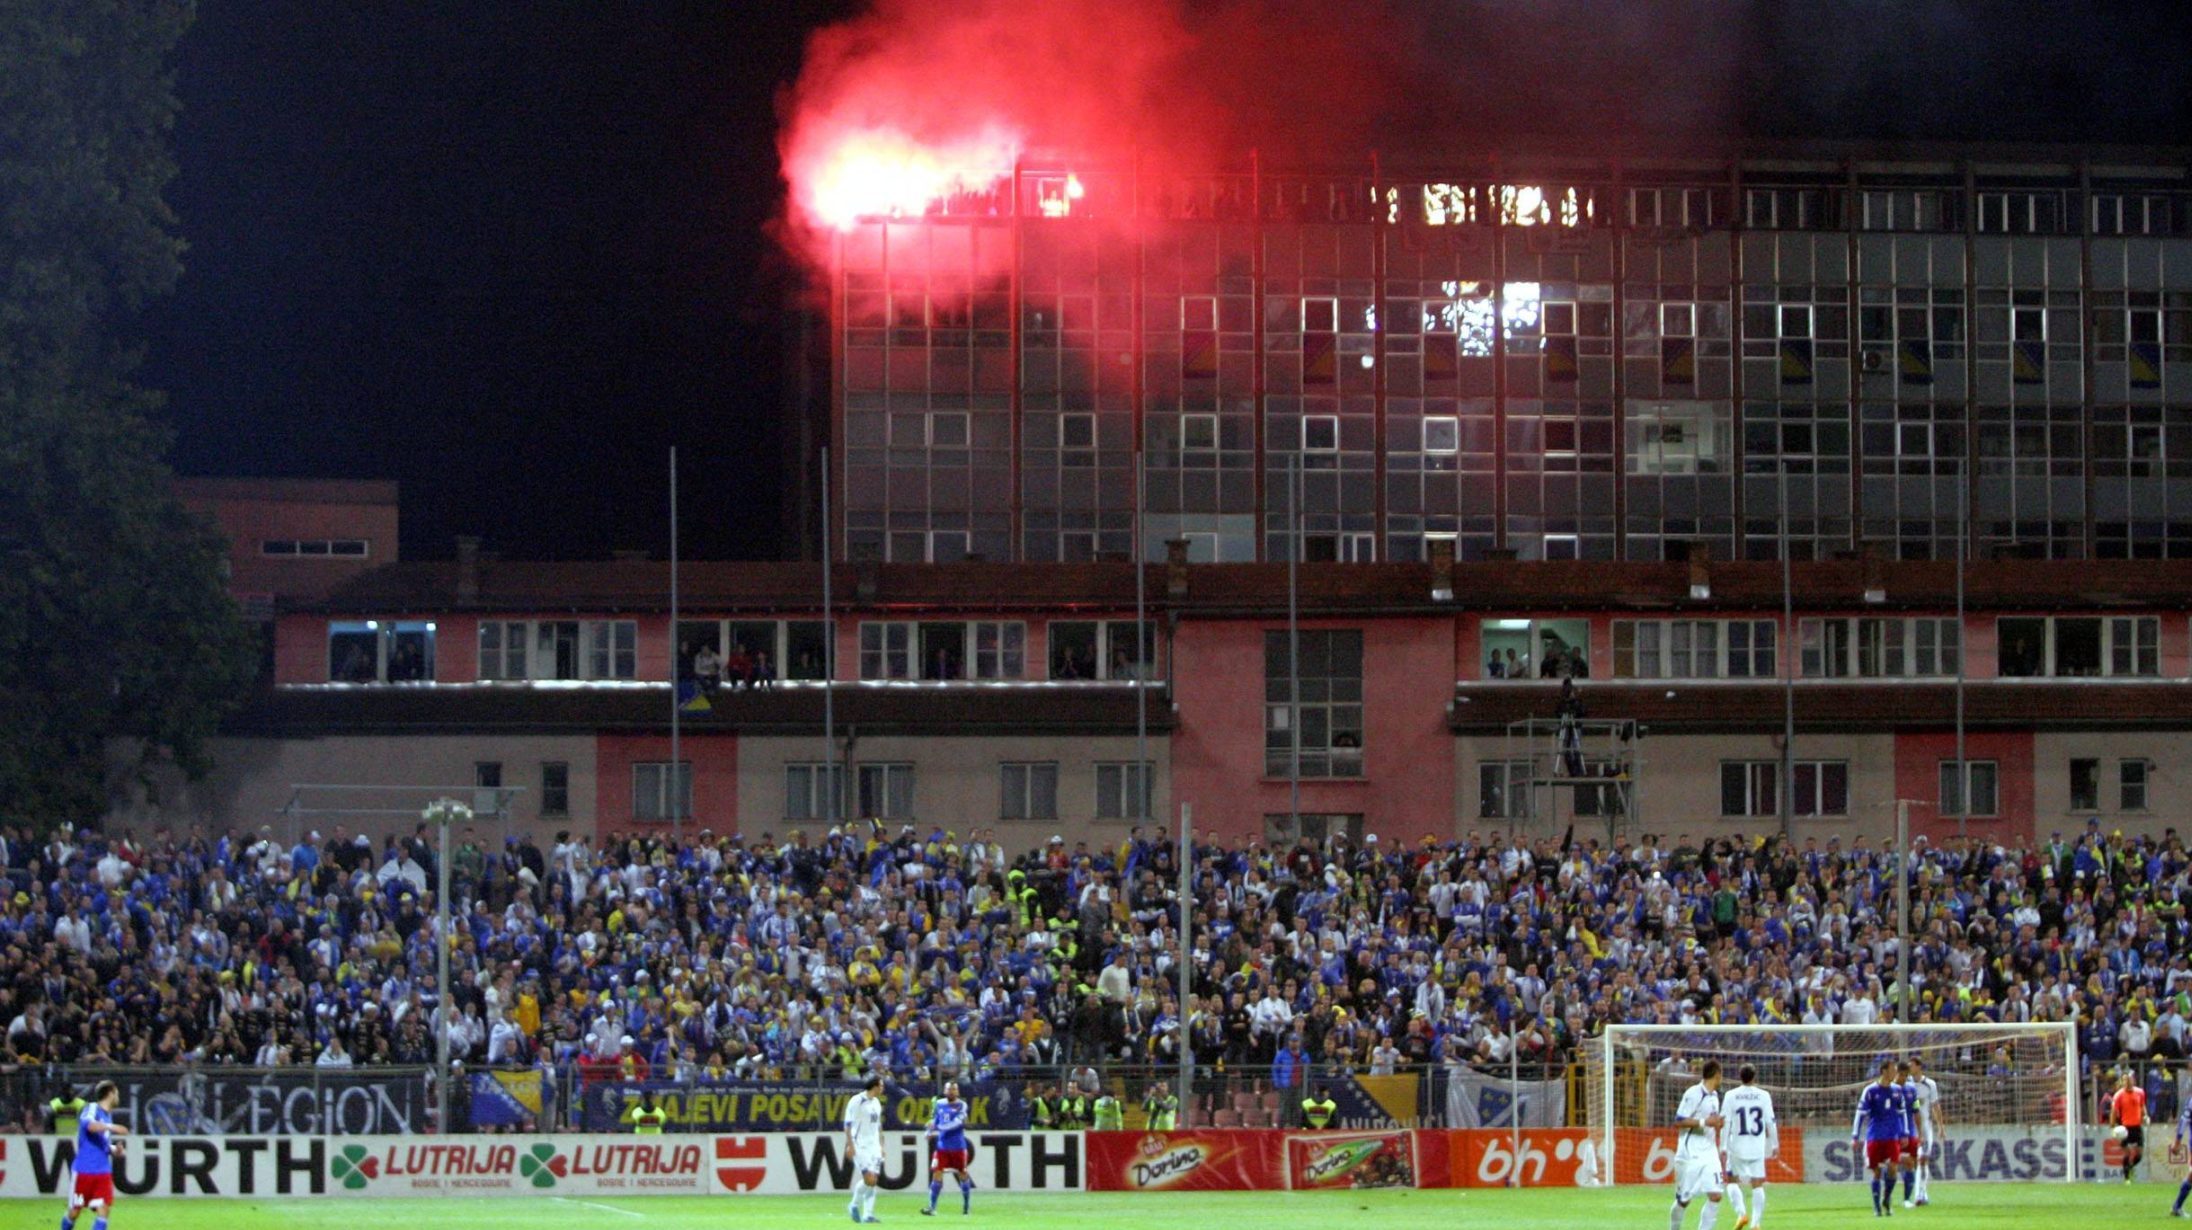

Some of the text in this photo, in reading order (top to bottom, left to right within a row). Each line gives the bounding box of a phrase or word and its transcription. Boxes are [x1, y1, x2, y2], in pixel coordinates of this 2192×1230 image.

[1735, 1106, 1764, 1136] 13
[384, 1145, 516, 1175] LUTRIJA
[571, 1145, 701, 1174] LUTRIJA
[1133, 1147, 1200, 1188] Dorino
[1306, 1149, 1351, 1182] Dorino
